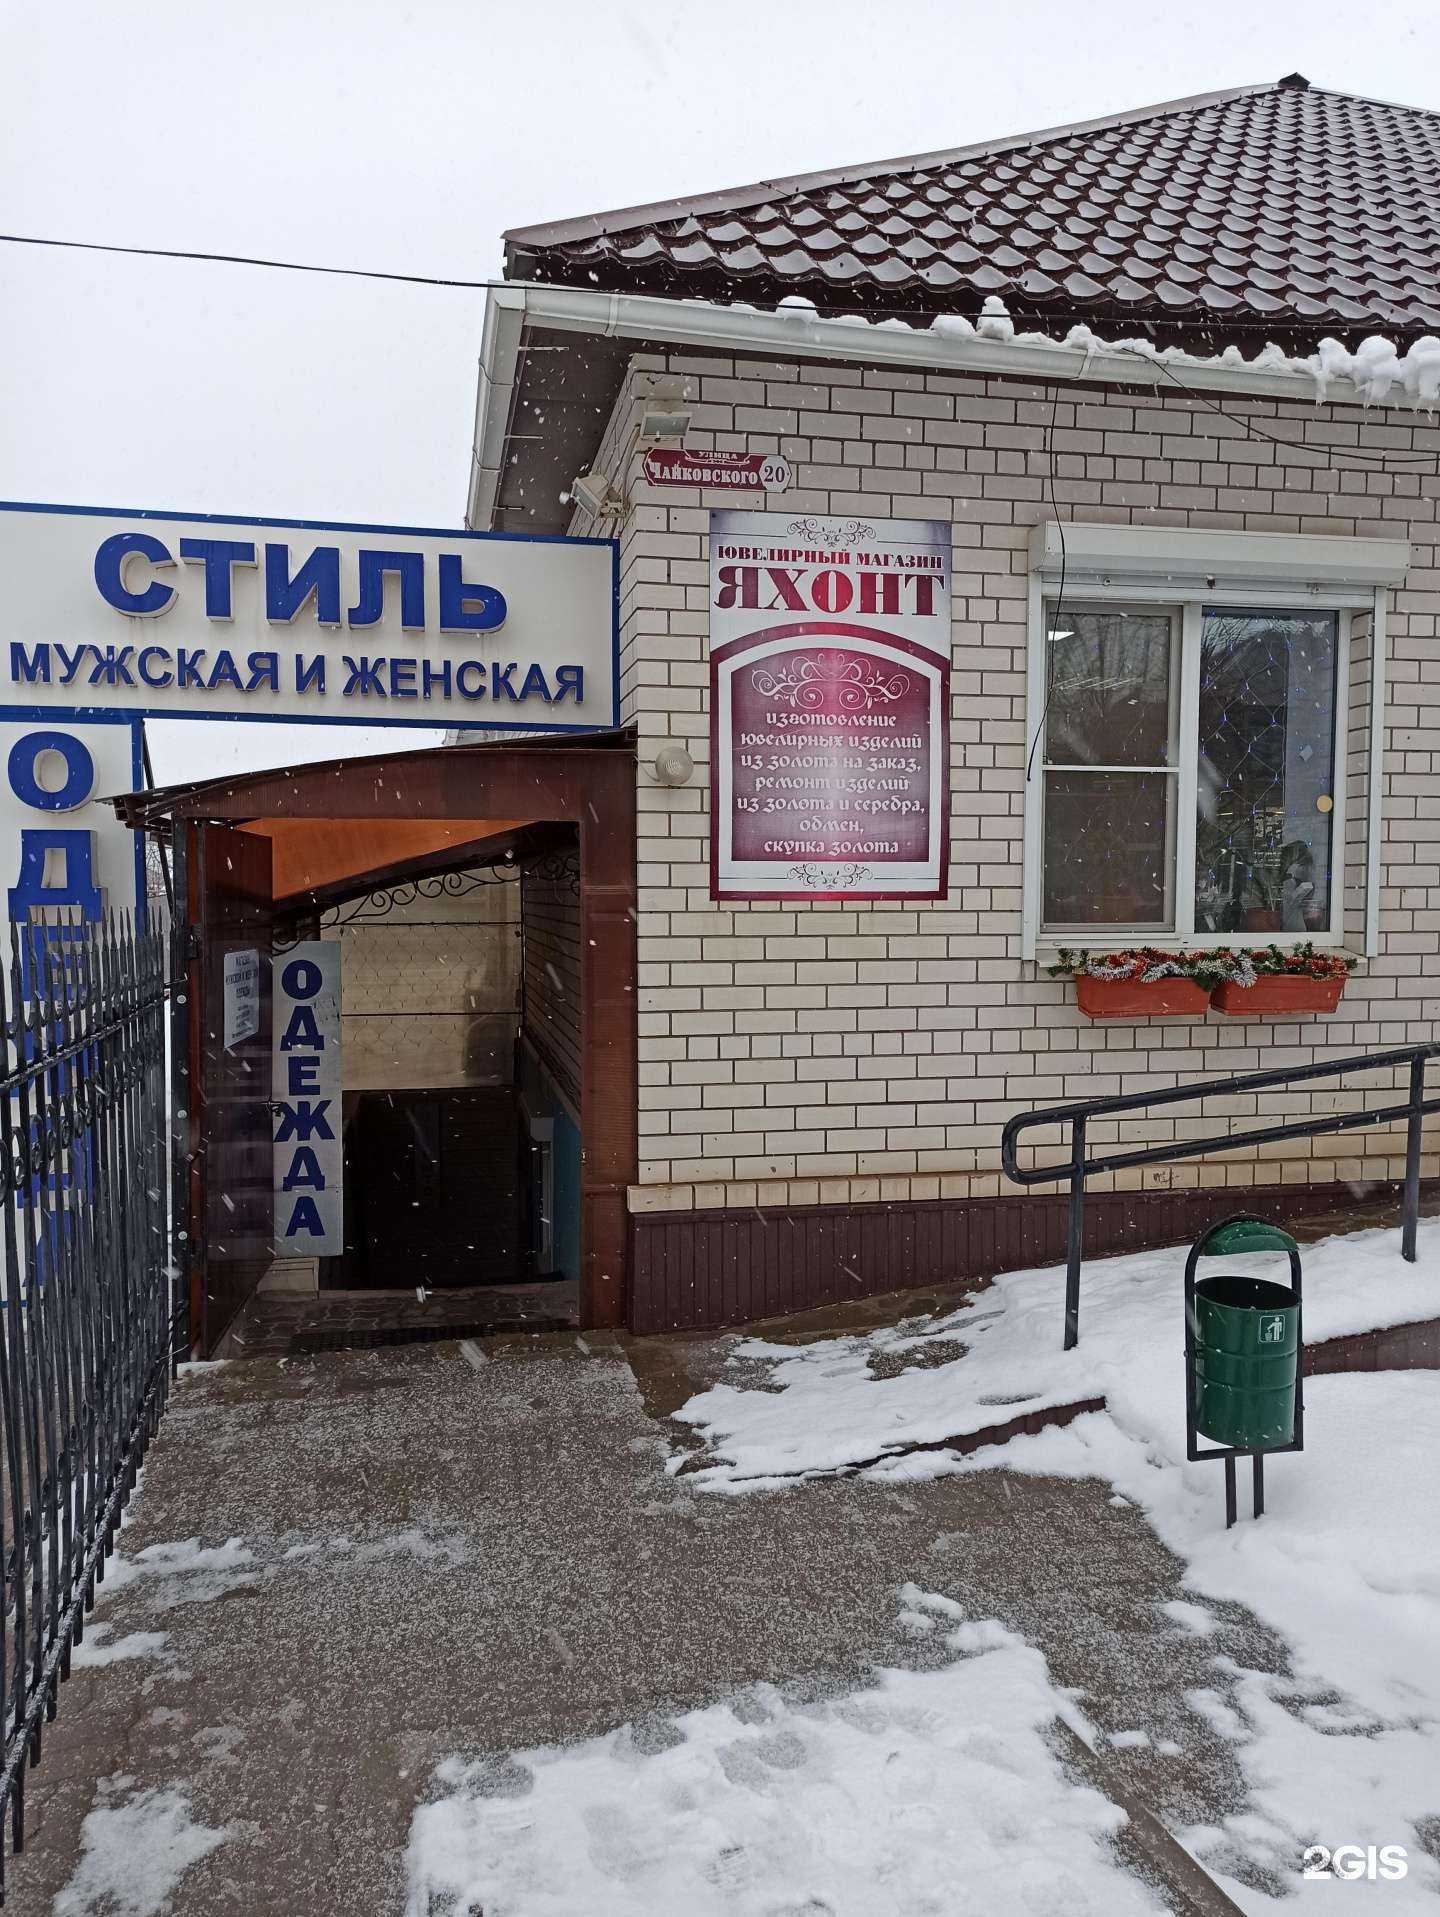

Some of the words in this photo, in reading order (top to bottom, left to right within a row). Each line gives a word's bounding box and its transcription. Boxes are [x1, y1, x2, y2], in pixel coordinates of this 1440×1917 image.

[763, 466, 786, 483] 20
[717, 545, 850, 565] ЮВЕЛИРНЫЙ
[855, 552, 943, 569] МАГАЗИН
[94, 532, 509, 634] СТИЛЬ
[713, 565, 946, 617] ЯХОНТ
[9, 642, 280, 693] МУЖСКАЯ
[295, 654, 328, 695] И
[343, 655, 586, 703] ЖЕНСКАЯ
[766, 712, 897, 728] изготовление
[740, 733, 843, 749] ювелирных
[848, 734, 922, 751] изделий
[740, 754, 763, 770] из
[766, 755, 838, 771] золота
[843, 757, 863, 770] на
[755, 776, 831, 792] ремонт
[836, 775, 910, 793] изделий
[736, 796, 760, 813] из
[762, 796, 834, 813] золота
[839, 798, 850, 810] и
[854, 796, 926, 815] серебра,
[799, 816, 864, 834] обмен,
[763, 838, 825, 854] скупка
[828, 838, 899, 855] золота
[273, 958, 336, 1237] ОДЕЖДА
